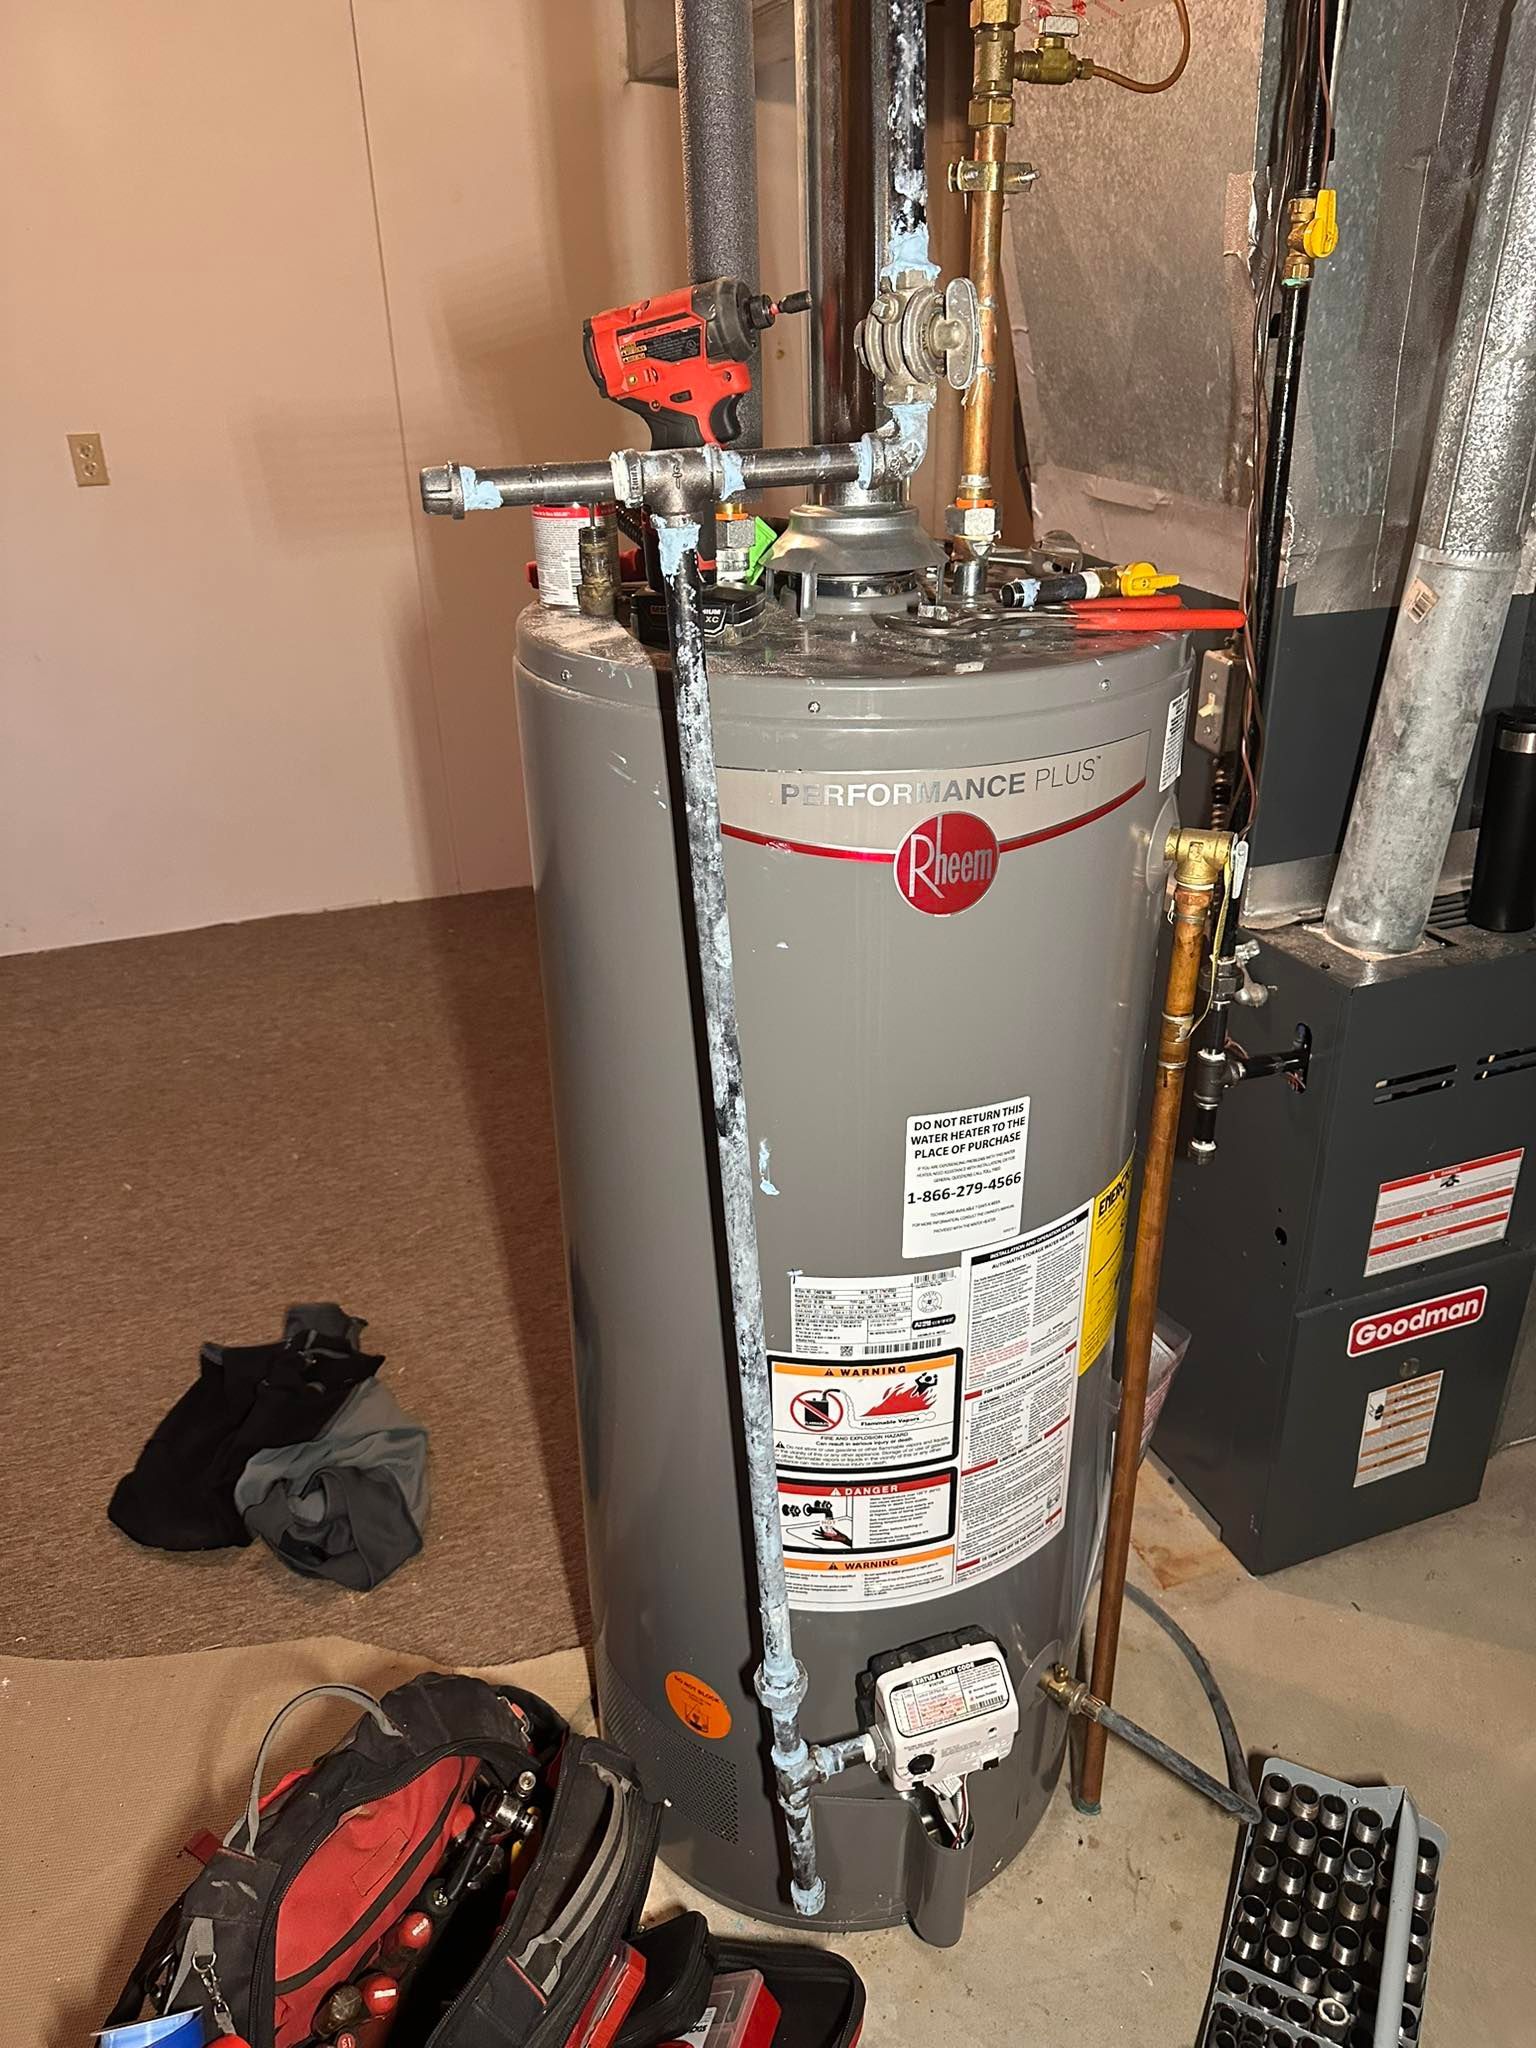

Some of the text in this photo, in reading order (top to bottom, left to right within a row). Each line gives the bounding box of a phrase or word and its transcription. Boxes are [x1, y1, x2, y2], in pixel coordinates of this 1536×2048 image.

[705, 616, 720, 624] XC
[780, 772, 1026, 807] PERFORMANCE
[909, 814, 994, 899] Rheem
[911, 1116, 1026, 1145] WATER HEATER TO THE
[914, 1103, 1024, 1131] DO NOT RETURN THIS
[915, 1131, 1021, 1159] PLACE OF PURCHASE
[907, 1172, 1022, 1205] 1-866-279-4566
[1355, 1298, 1479, 1346] Goodman
[840, 1366, 906, 1376] WARNING
[845, 1484, 898, 1496] DANGER
[845, 1559, 898, 1570] WARNING
[912, 1661, 975, 1686] STATUS LIGHT CODE
